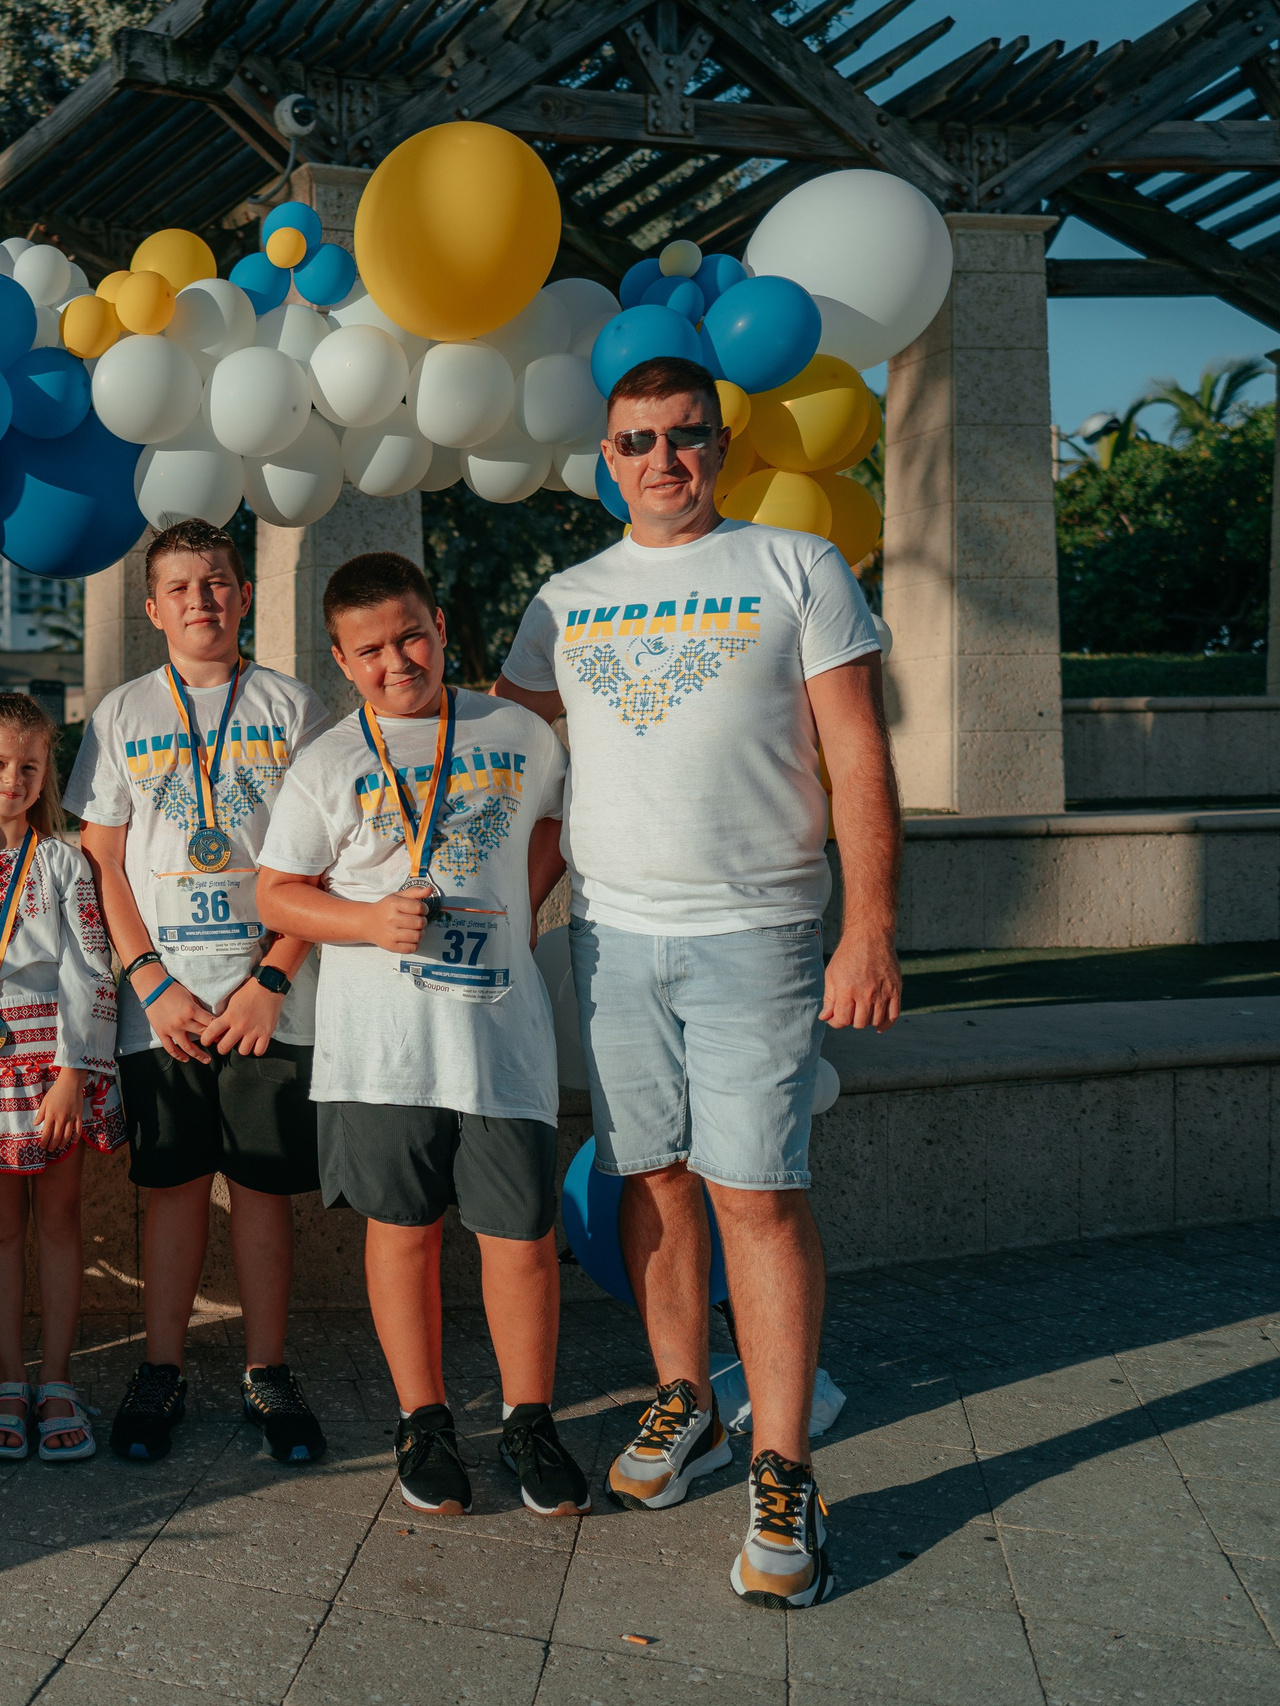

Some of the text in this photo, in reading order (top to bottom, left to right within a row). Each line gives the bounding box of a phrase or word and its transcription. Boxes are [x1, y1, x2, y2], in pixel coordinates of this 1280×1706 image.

[190, 890, 230, 924] 36
[442, 930, 488, 966] 37
[423, 981, 450, 992] Coupon
